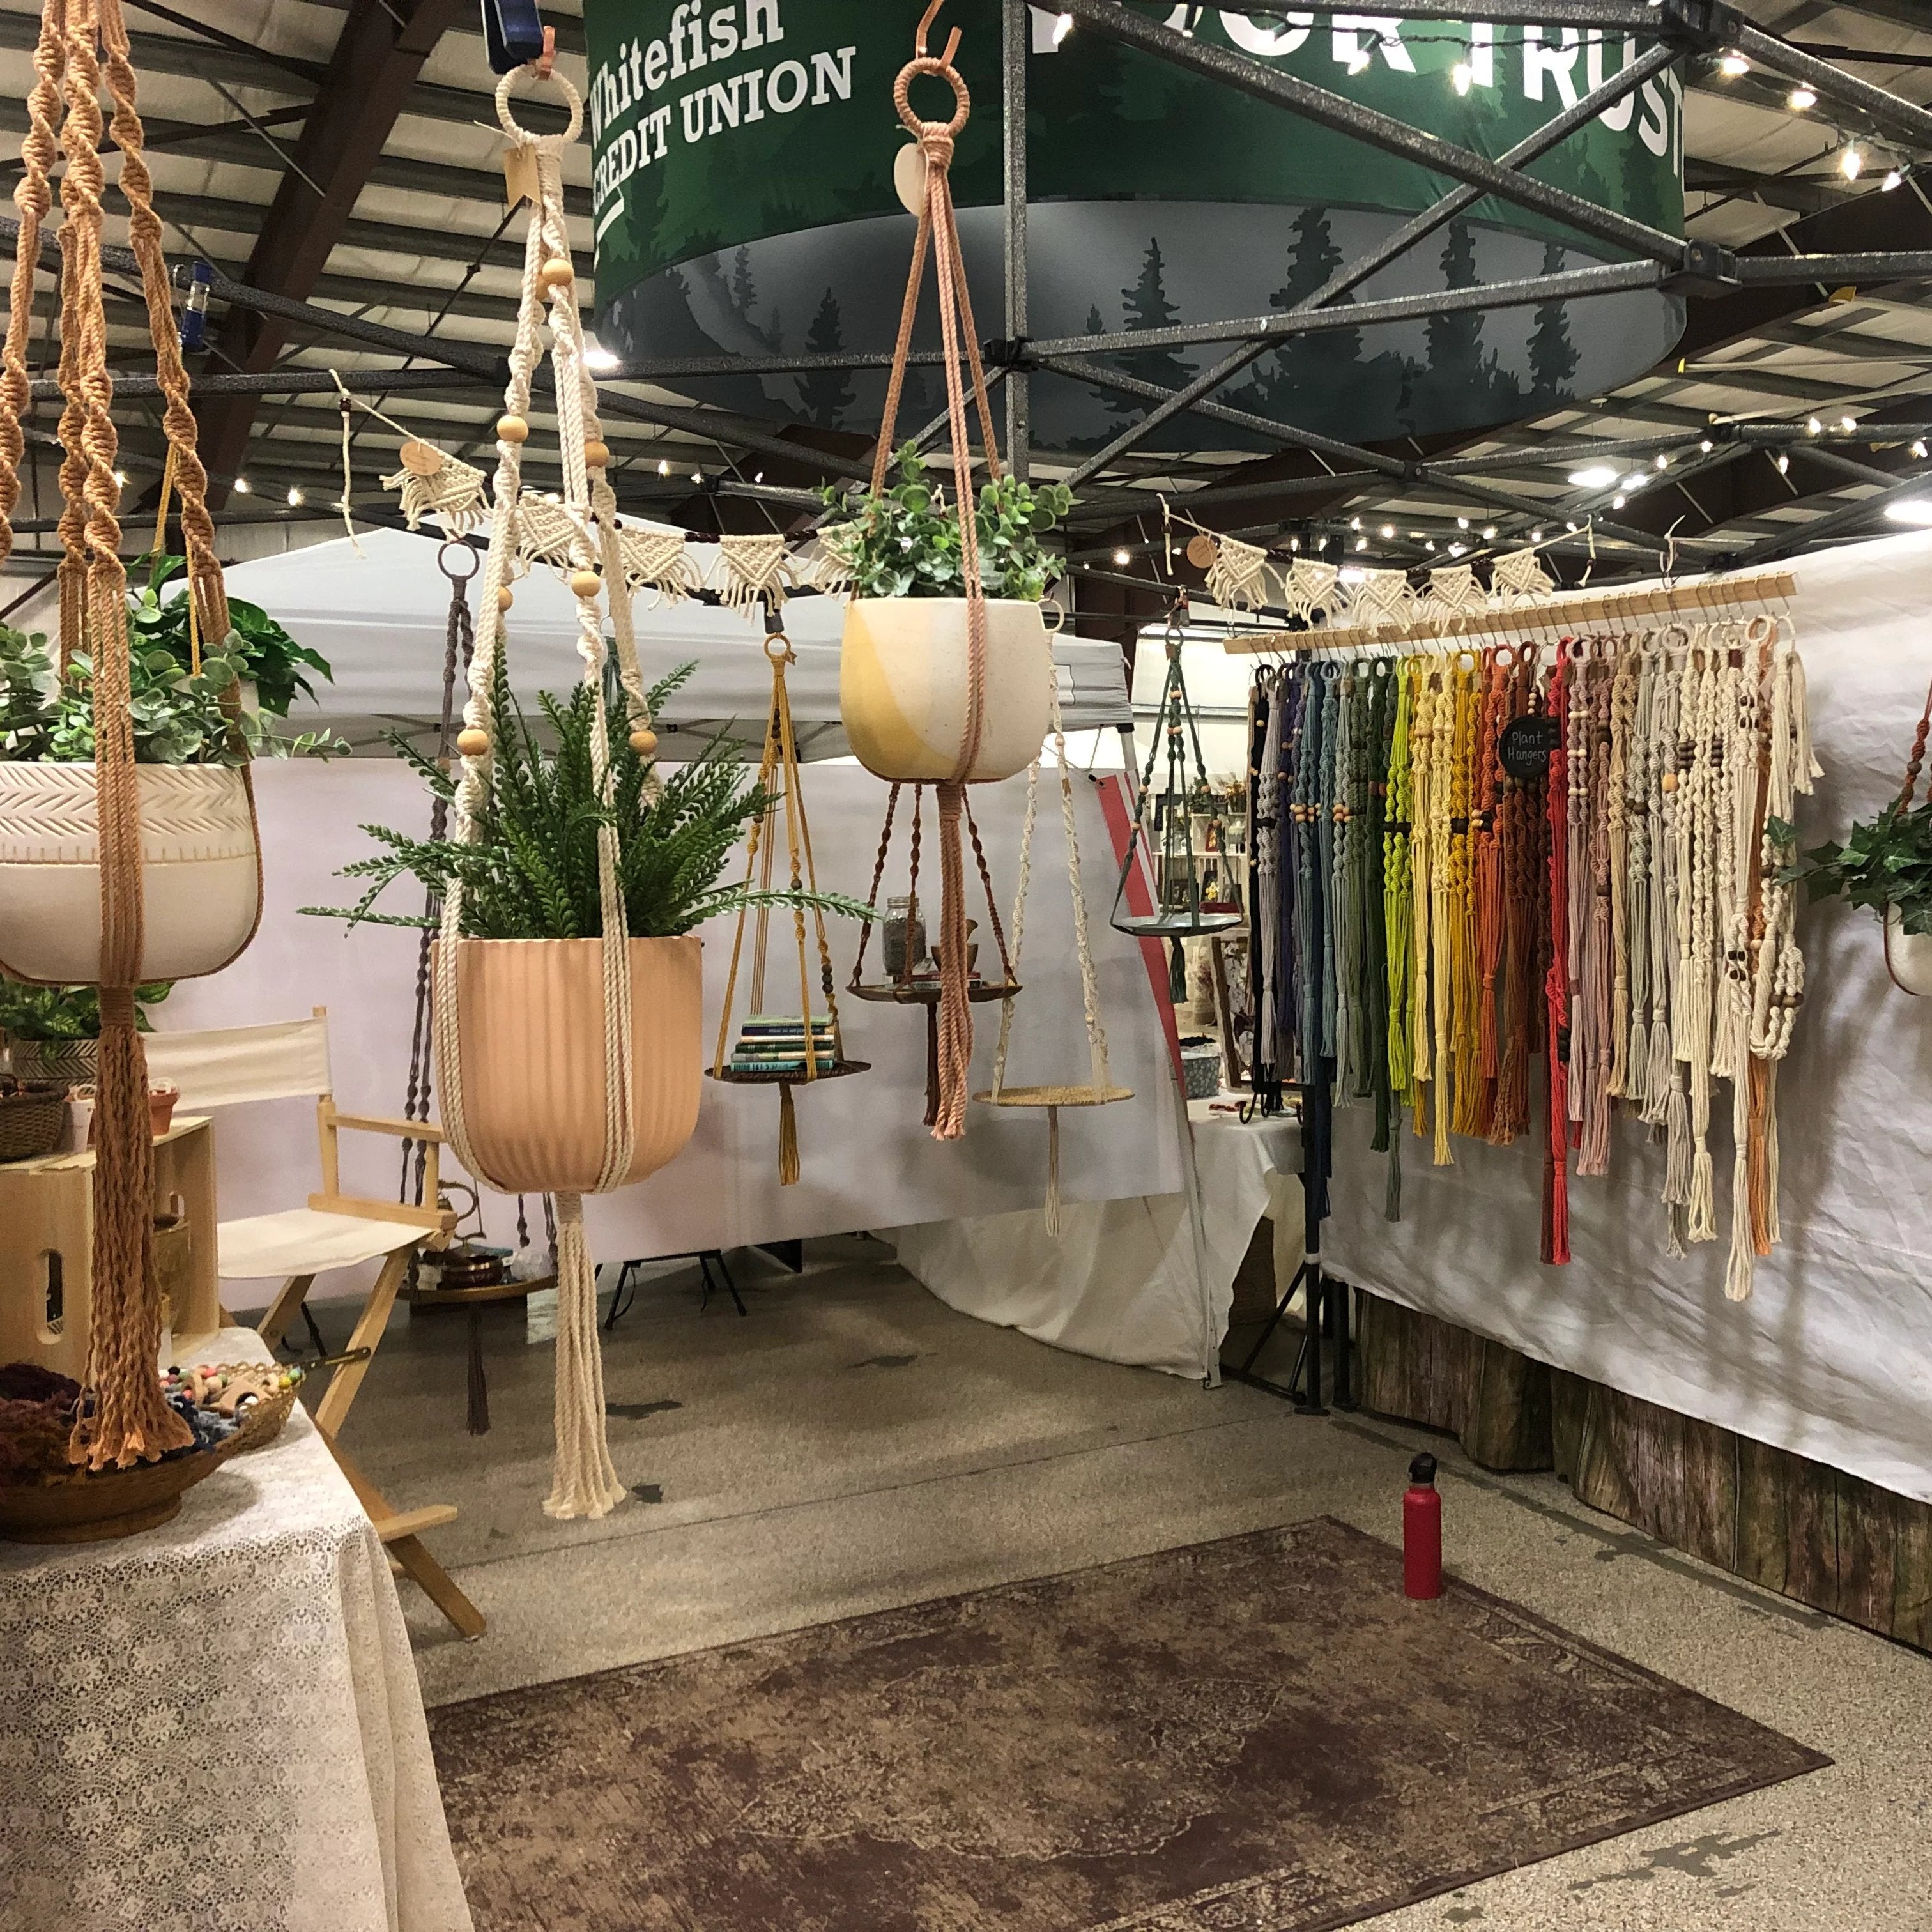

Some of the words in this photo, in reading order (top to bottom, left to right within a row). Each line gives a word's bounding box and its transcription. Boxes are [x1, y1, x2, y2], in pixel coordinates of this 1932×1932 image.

[590, 0, 784, 150] Whitefish
[593, 105, 671, 215] CREDIT
[680, 46, 856, 144] UNION
[1508, 746, 1547, 766] Hangers
[1512, 730, 1544, 746] Plant
